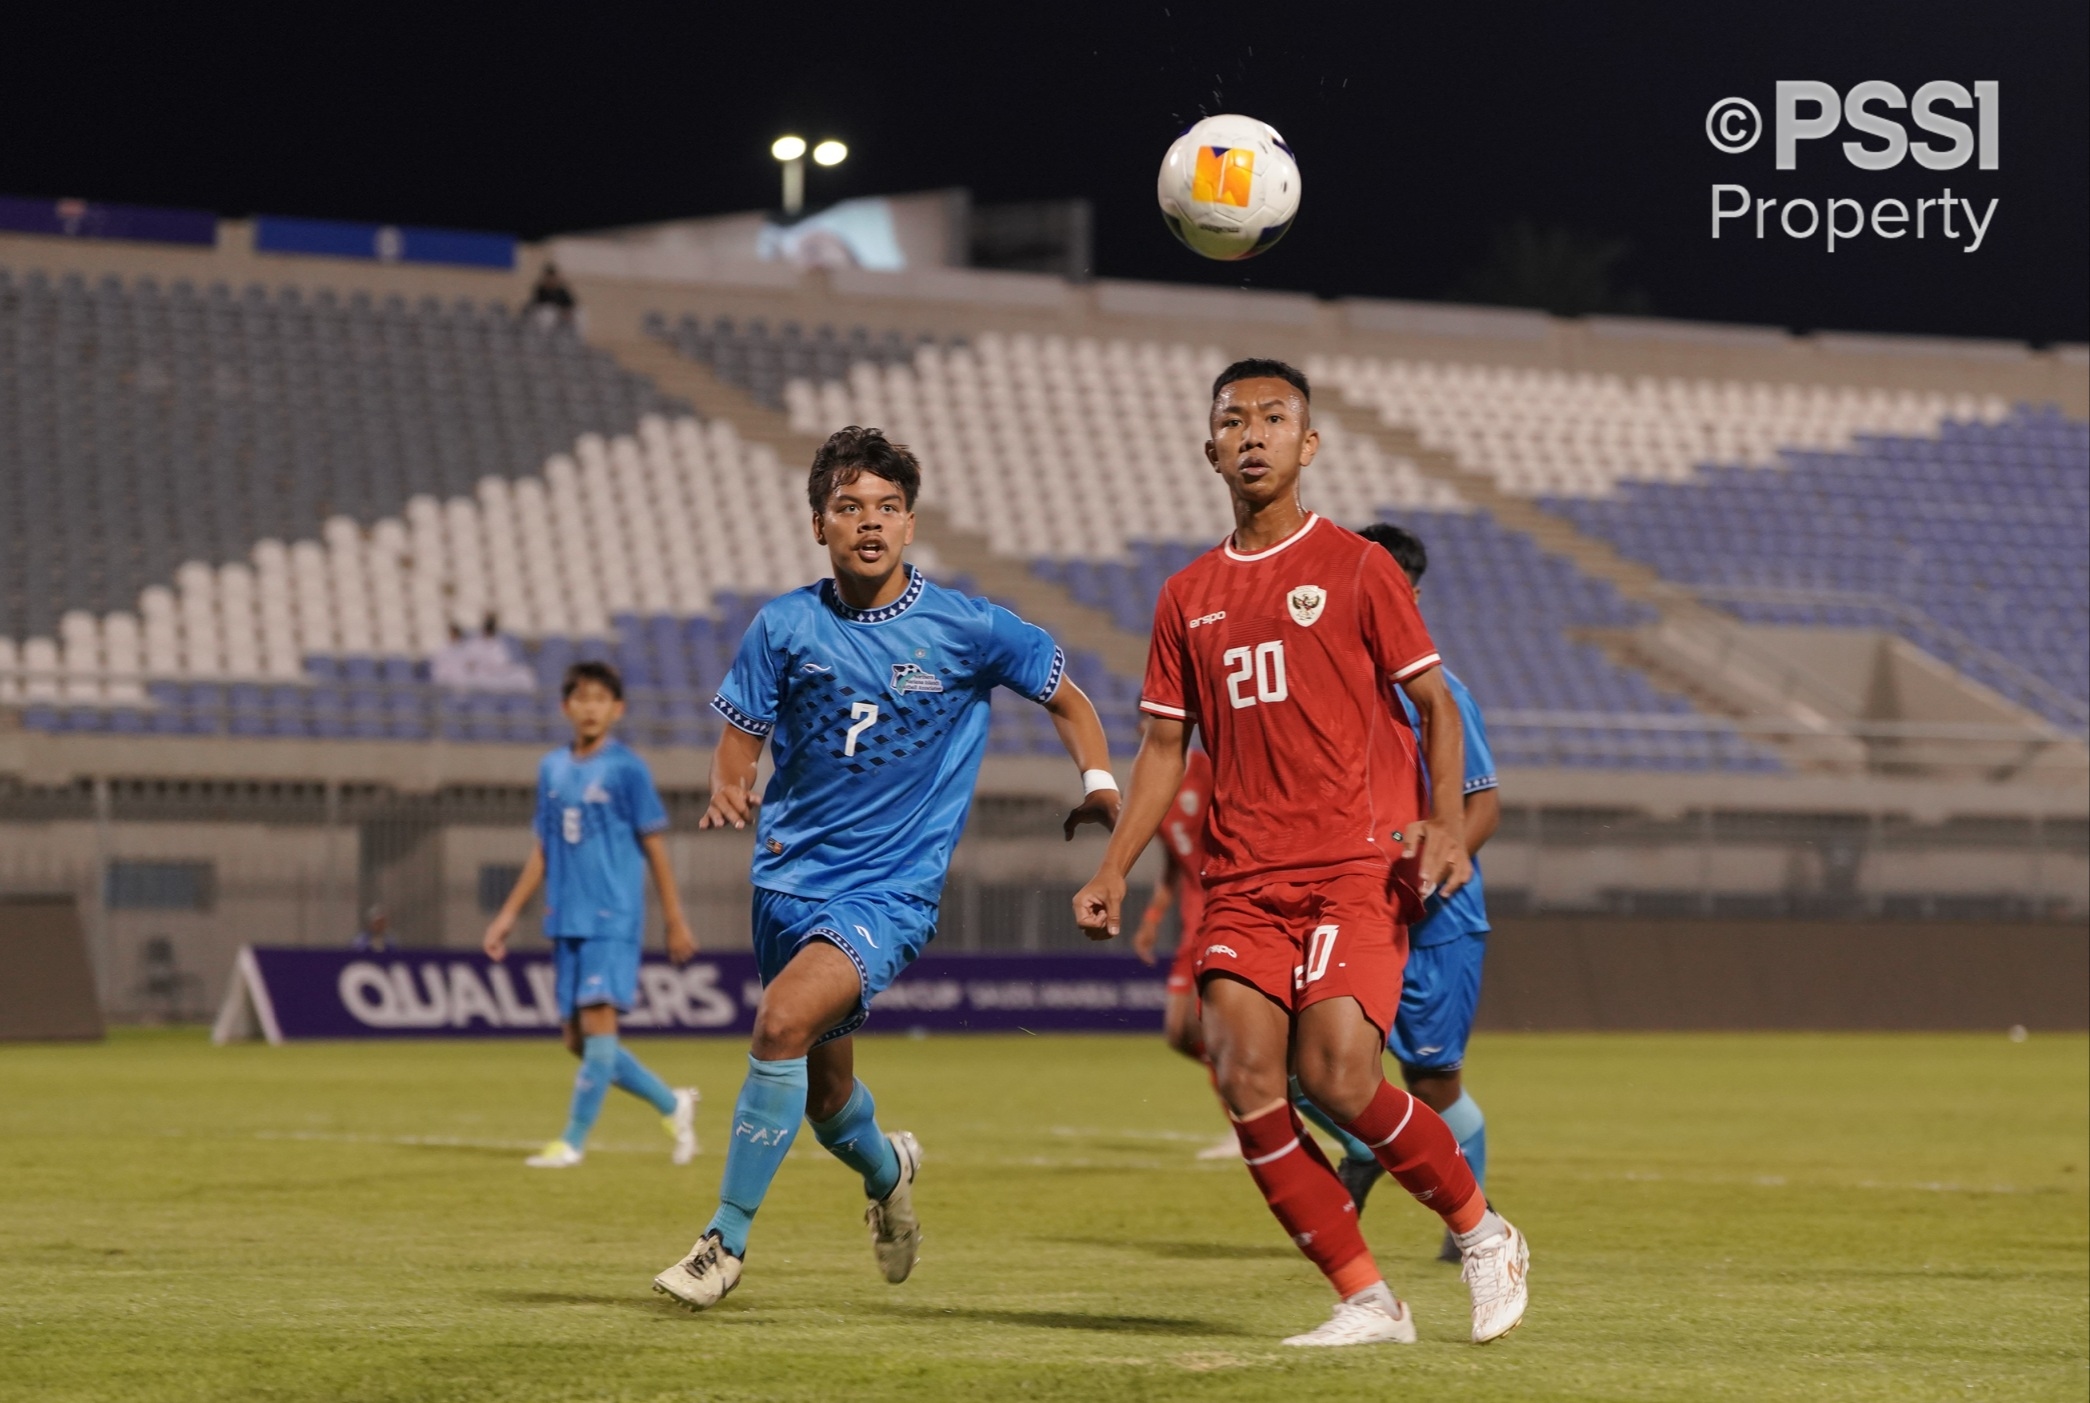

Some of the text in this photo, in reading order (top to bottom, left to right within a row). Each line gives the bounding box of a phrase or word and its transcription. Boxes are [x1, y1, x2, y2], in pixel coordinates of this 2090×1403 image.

[1190, 610, 1226, 629] erspo
[1223, 640, 1289, 709] 20
[844, 702, 879, 758] 7
[339, 961, 737, 1029] QUALIERS
